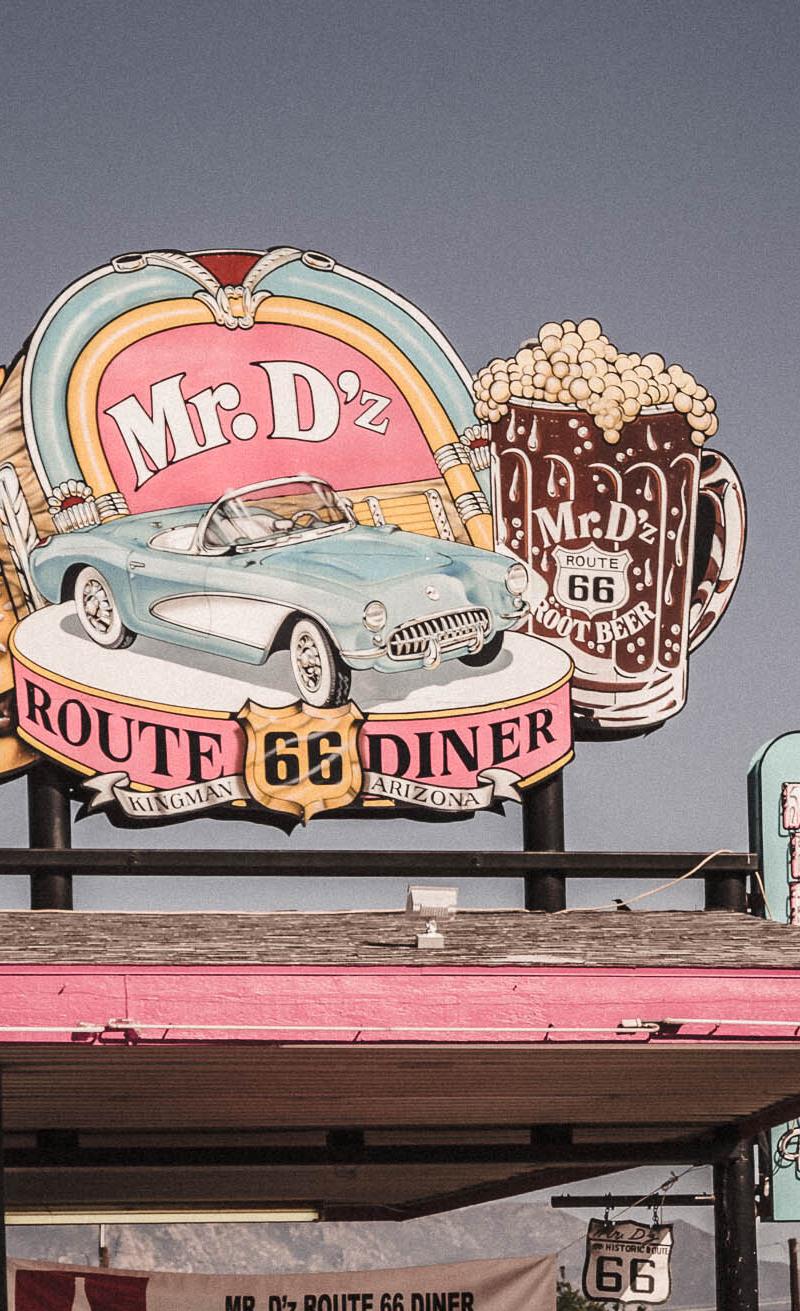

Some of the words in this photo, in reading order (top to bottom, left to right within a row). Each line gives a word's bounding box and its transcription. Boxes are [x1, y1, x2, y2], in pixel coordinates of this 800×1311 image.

[103, 371, 258, 492] Mr.
[249, 360, 392, 443] D'z
[532, 501, 603, 548] Mr.
[604, 501, 658, 545] D'z
[566, 555, 619, 569] ROUTE
[568, 574, 615, 603] 66
[532, 599, 592, 642] ROOT
[595, 601, 656, 643] BEER
[24, 678, 225, 783] ROUTE
[264, 731, 343, 786] 66
[366, 708, 557, 778] DINER
[129, 781, 235, 813] KINGMAN
[371, 776, 481, 807] ARIZONA
[606, 1243, 645, 1254] HISTORIC
[596, 1255, 655, 1294] 66
